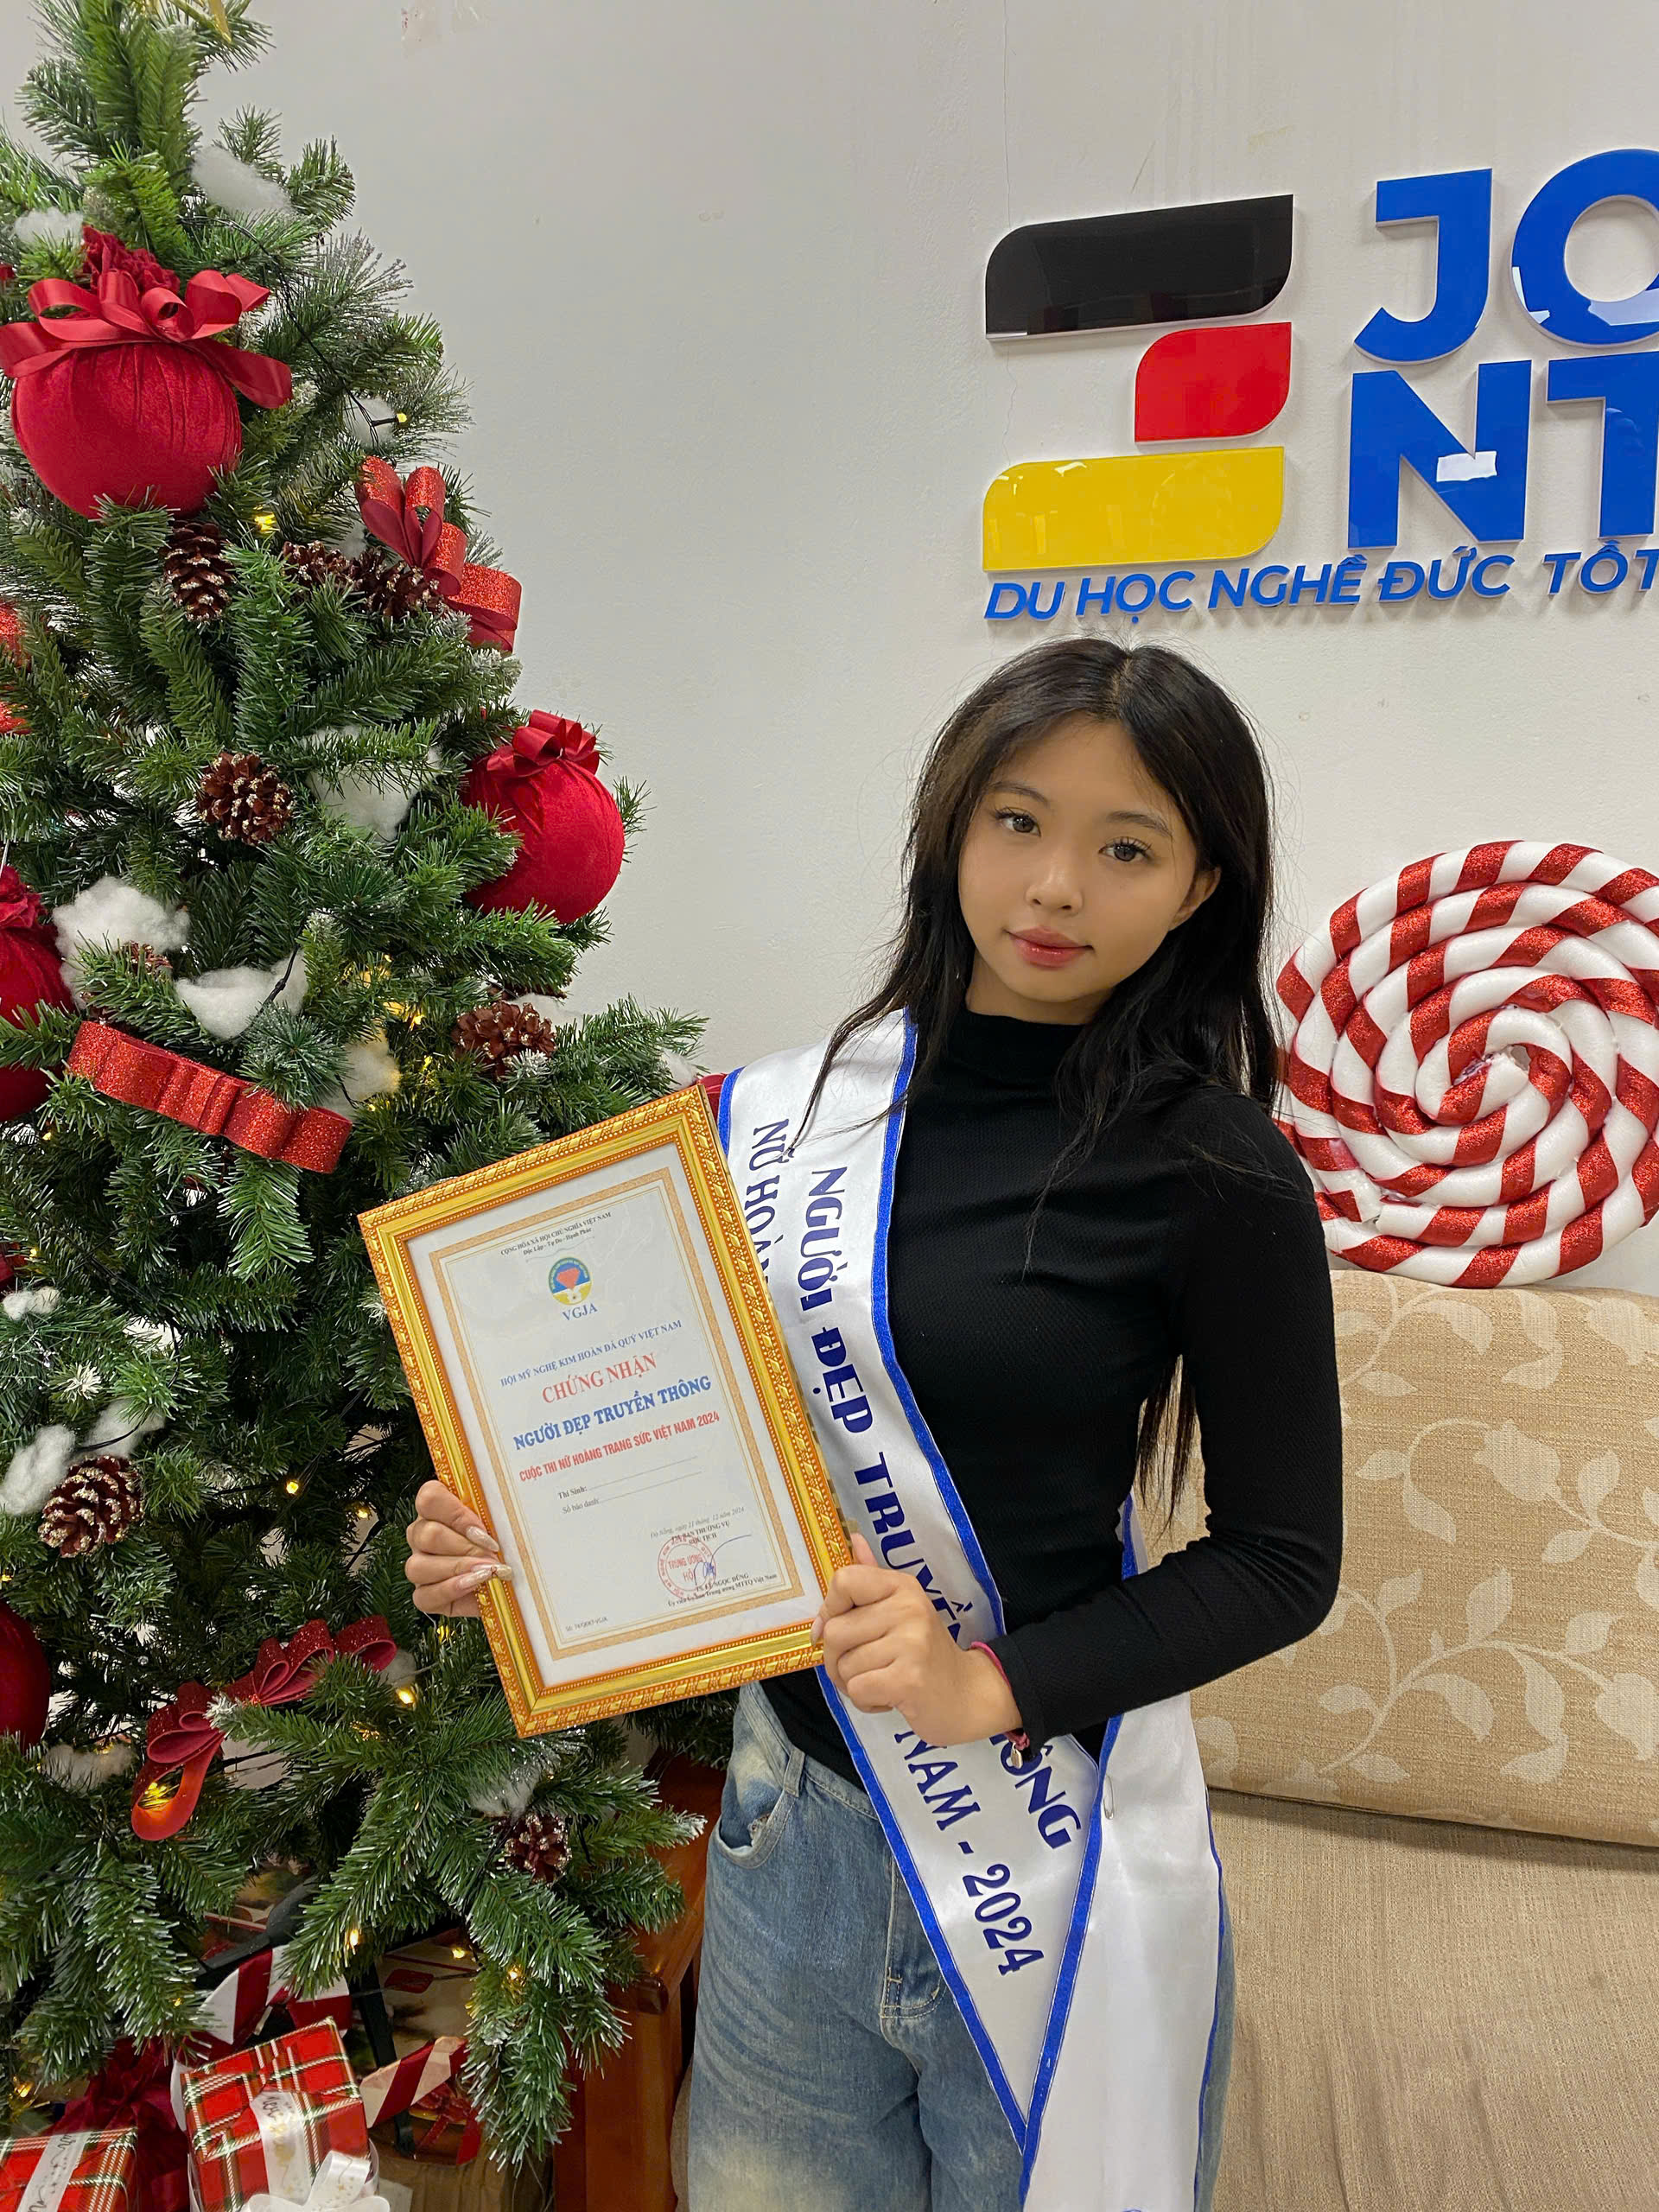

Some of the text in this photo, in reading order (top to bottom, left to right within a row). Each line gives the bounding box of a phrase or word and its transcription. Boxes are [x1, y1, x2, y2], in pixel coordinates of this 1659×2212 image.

[984, 582, 1066, 620] DU
[1076, 570, 1196, 623] HỌC
[1208, 554, 1368, 608] NGHỀ
[1378, 545, 1516, 601] ĐỨC
[597, 1211, 612, 1221] NAM
[798, 1166, 848, 1311] NGƯỜI
[563, 1303, 598, 1321] VGJA
[500, 1319, 682, 1387] HỘI MỸ NGHỆ KIM HOÀN ĐÁ QUÝ VIỆT NAM
[542, 1352, 657, 1403] CHỨNG NHẬN
[811, 1326, 873, 1433] ĐẸP
[513, 1422, 562, 1451] NGƯỜI
[563, 1414, 591, 1436] ĐẸP
[594, 1390, 655, 1425] TRUYỀN
[519, 1465, 543, 1482] CUỘC
[543, 1460, 557, 1474] THI
[572, 1446, 603, 1466] HOÀNG
[603, 1437, 633, 1456] TRANG
[634, 1430, 652, 1446] SỨC
[652, 1424, 672, 1441] VIỆT
[672, 1417, 696, 1434] NAM
[696, 1409, 720, 1427] 2024
[558, 1485, 588, 1499] Thí Sinh:
[854, 1452, 973, 1643] TRUYỀ
[957, 1841, 974, 1854] -
[962, 1864, 1044, 1975] 2024
